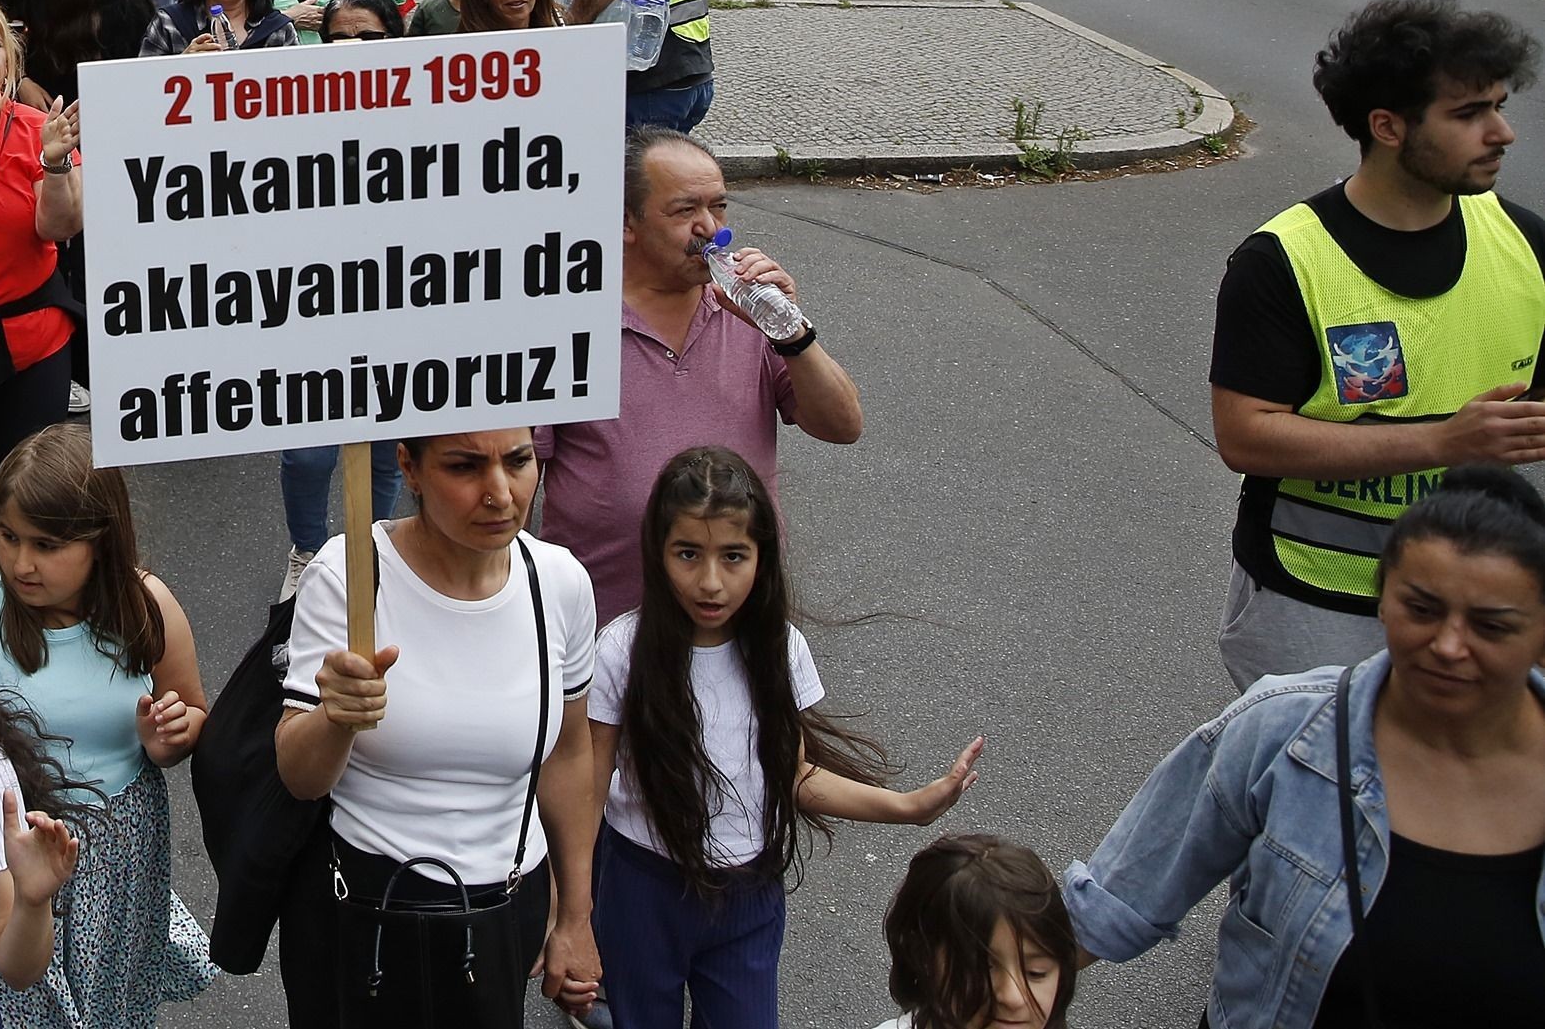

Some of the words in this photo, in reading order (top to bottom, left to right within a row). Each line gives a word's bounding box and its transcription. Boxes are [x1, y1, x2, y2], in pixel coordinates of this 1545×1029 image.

[163, 74, 193, 127] 2
[206, 65, 413, 124] Temmuz
[423, 47, 542, 105] 1993
[124, 138, 460, 225] Yakanları
[481, 125, 581, 195] da,
[103, 244, 503, 338] aklayanları
[523, 230, 604, 298] da
